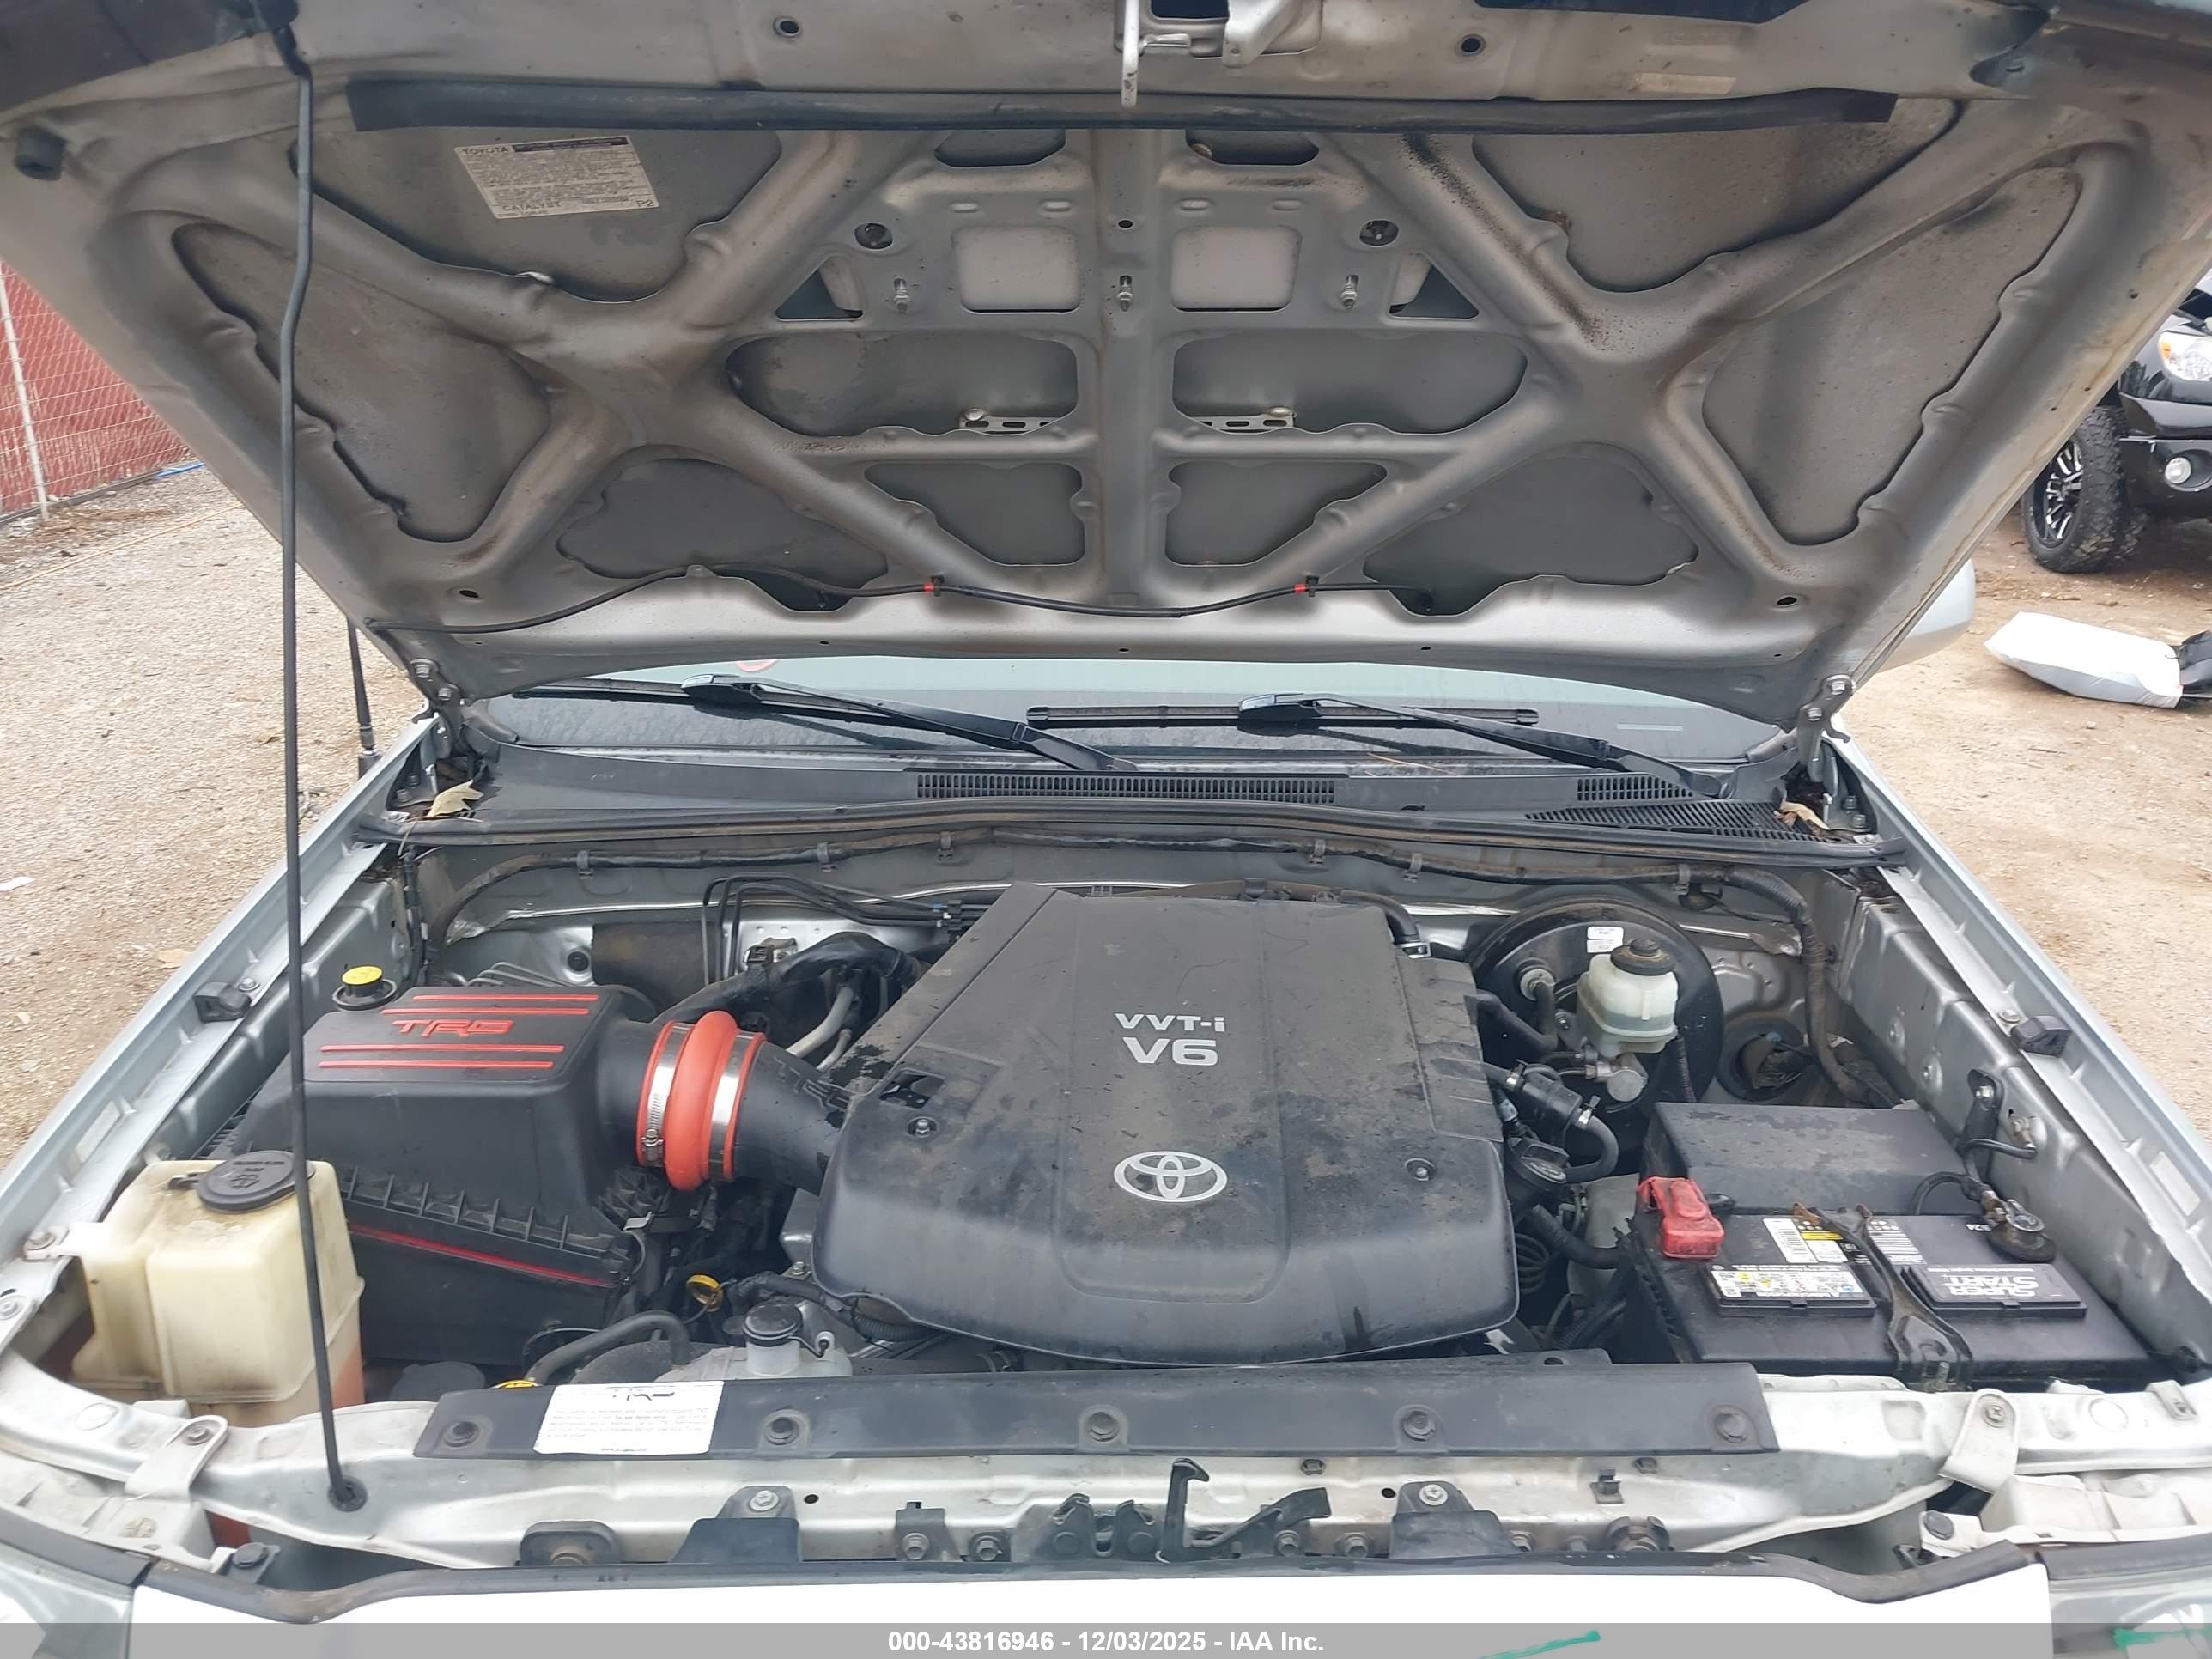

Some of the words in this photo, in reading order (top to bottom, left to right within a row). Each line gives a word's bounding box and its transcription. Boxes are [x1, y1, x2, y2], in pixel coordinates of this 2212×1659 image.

[462, 146, 508, 155] TOYOTA
[392, 1019, 514, 1038] TRD
[1115, 1013, 1224, 1032] VVT-i
[1122, 1037, 1218, 1066] V6
[1942, 1276, 2039, 1288] START
[1949, 1287, 2036, 1297] SUPER
